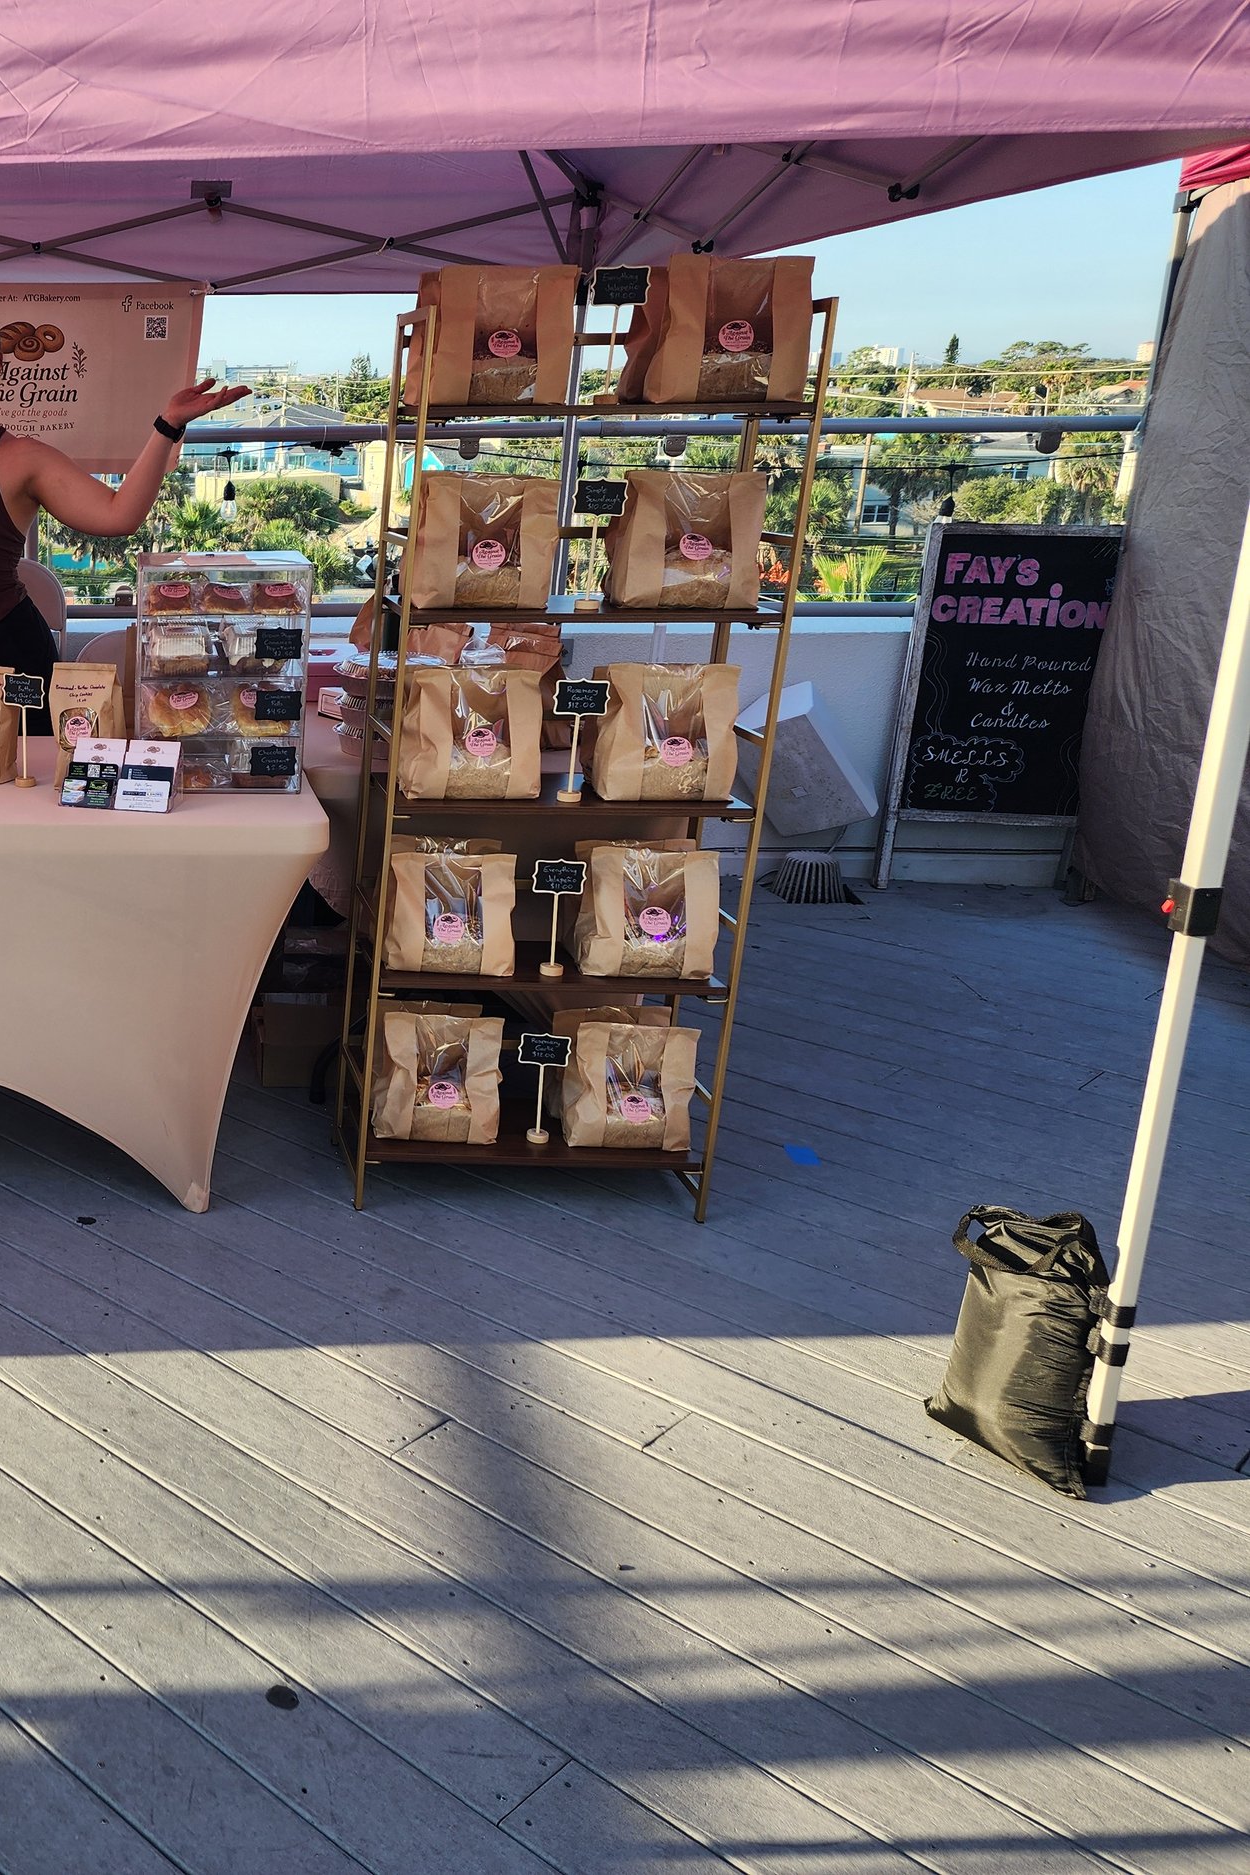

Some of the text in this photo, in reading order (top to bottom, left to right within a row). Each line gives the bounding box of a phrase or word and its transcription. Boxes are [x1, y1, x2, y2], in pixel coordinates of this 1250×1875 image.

[8, 294, 18, 302] At:
[22, 294, 81, 304] ATGBakery.com
[136, 301, 174, 310] Facebook
[20, 382, 79, 408] Grain
[11, 409, 26, 419] got
[27, 408, 41, 417] the
[42, 408, 68, 419] goods
[39, 421, 75, 431] BAKERY
[944, 552, 1040, 586] FAY'S
[966, 651, 1092, 671] Hand Poured
[969, 677, 1072, 695] Wax Melts
[1001, 701, 1014, 716] &
[971, 713, 1051, 729] Candles
[922, 746, 1009, 767] SMELLS
